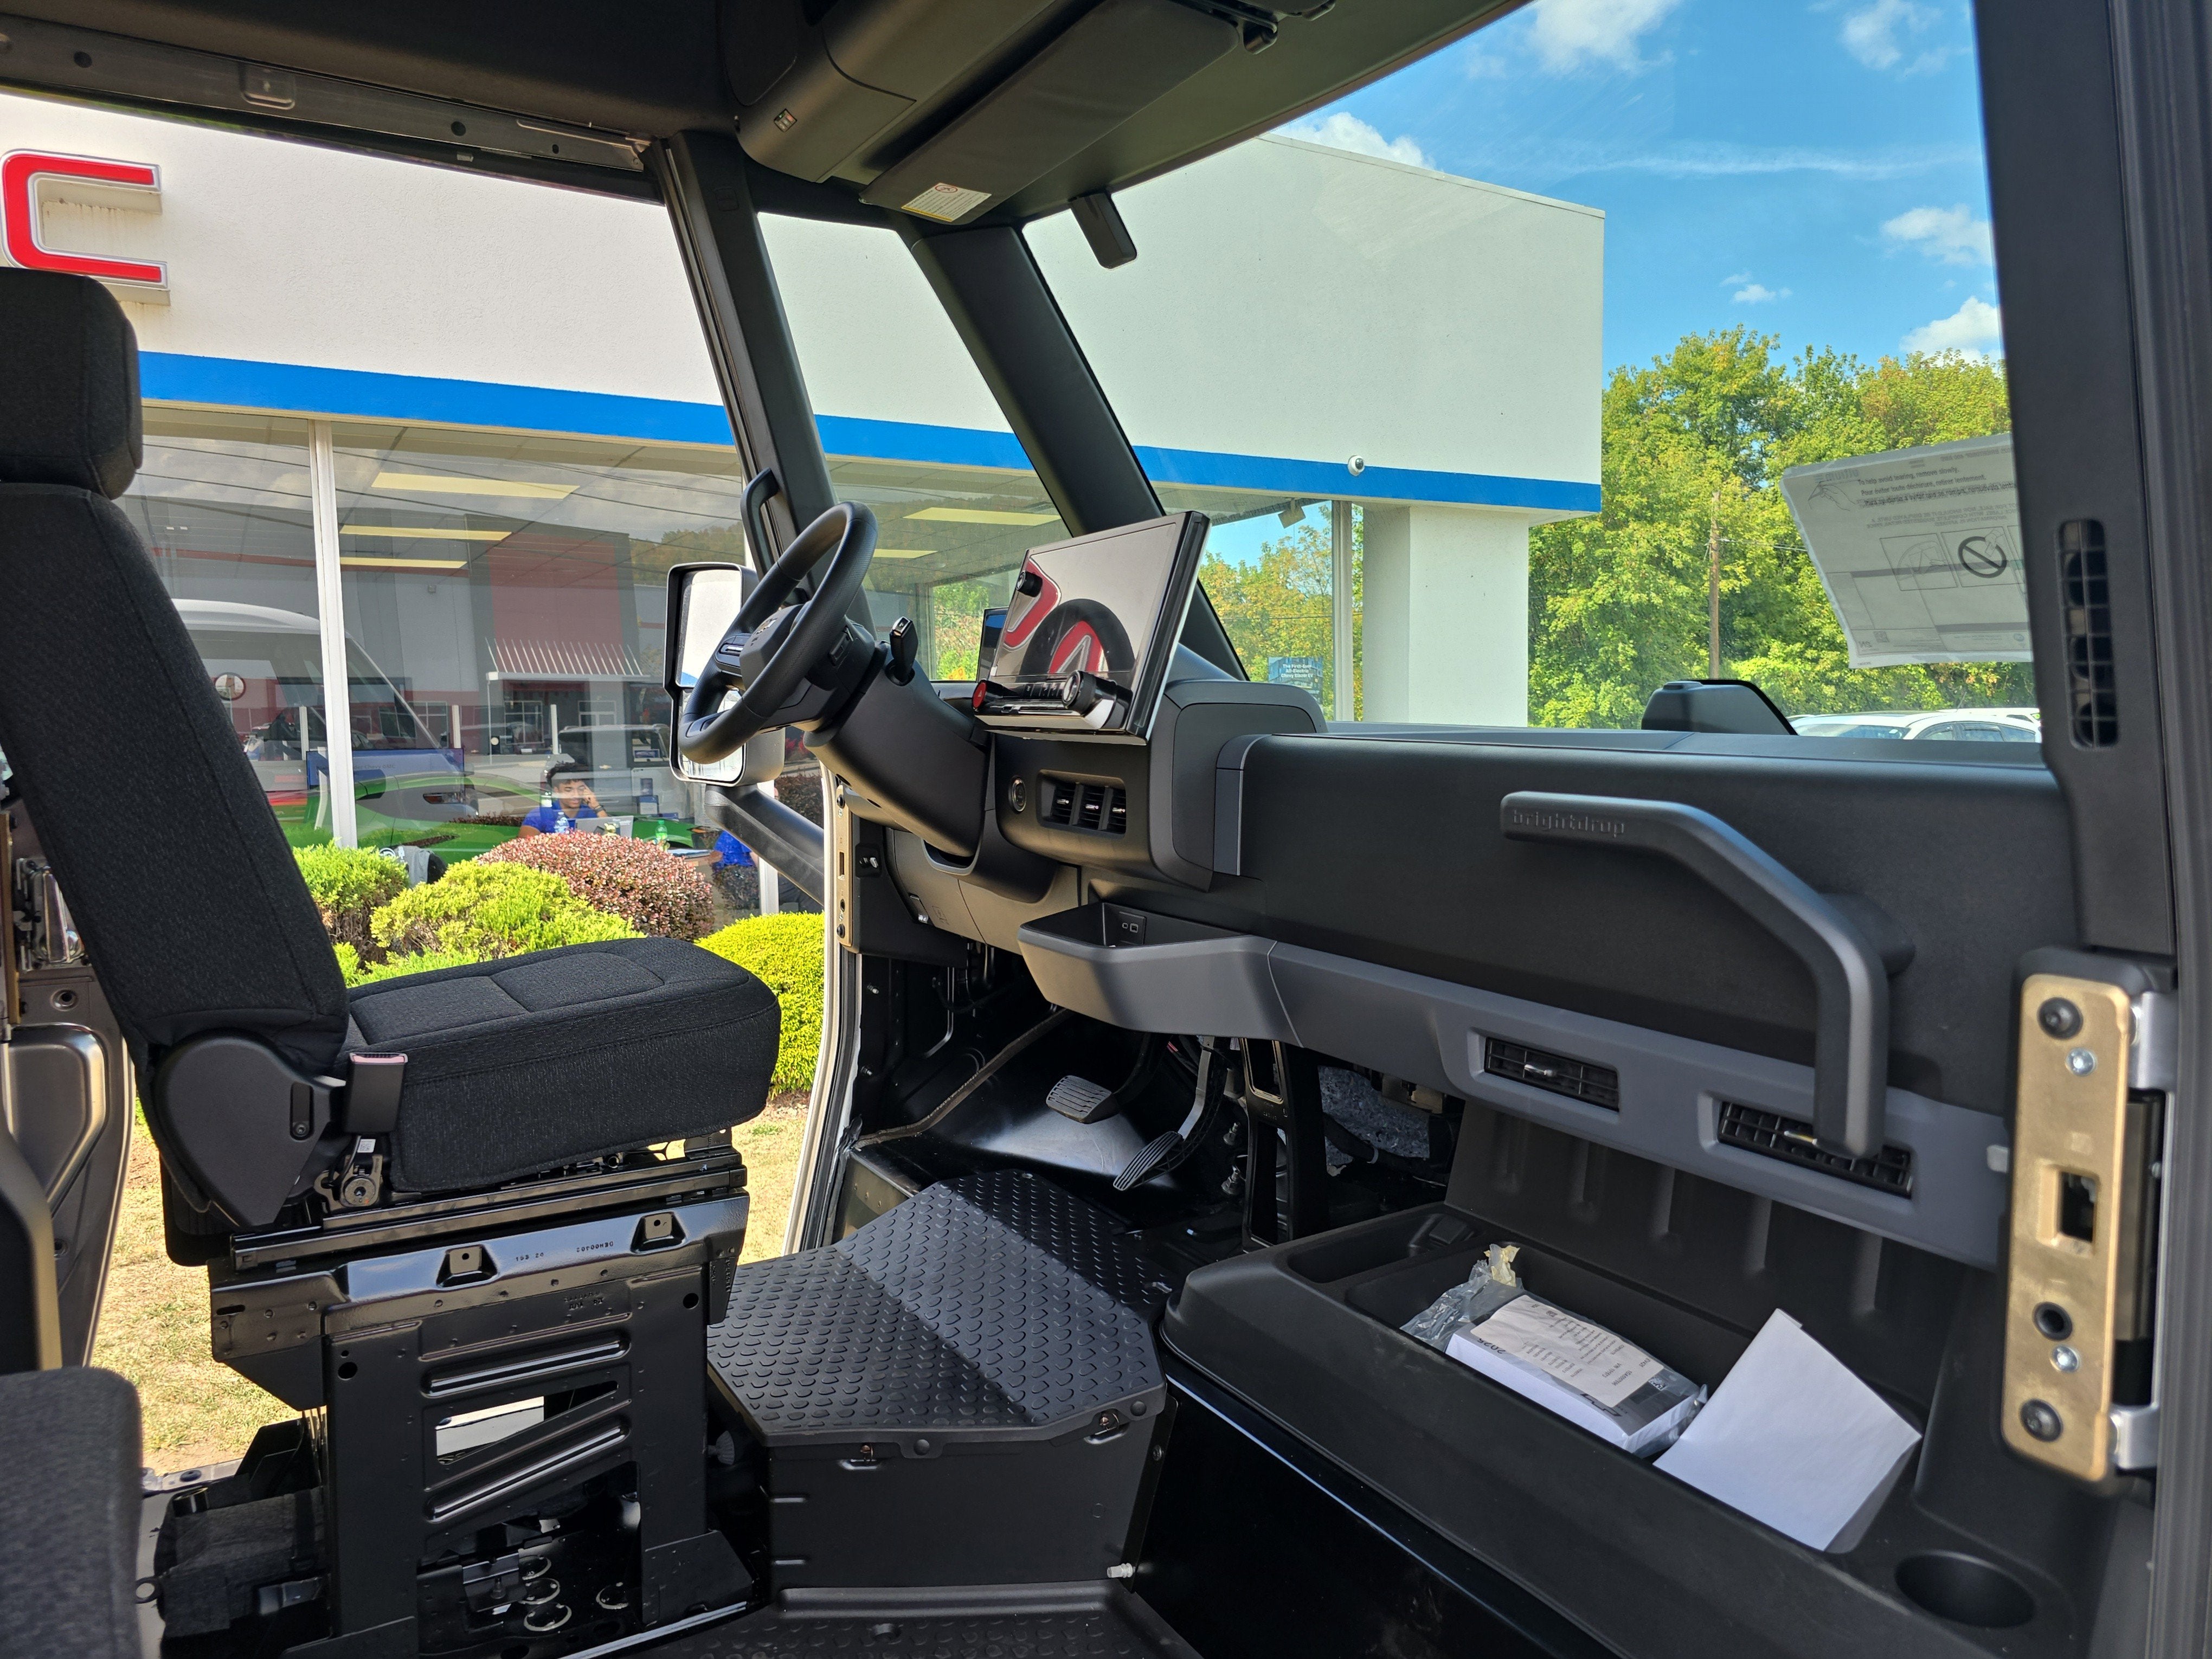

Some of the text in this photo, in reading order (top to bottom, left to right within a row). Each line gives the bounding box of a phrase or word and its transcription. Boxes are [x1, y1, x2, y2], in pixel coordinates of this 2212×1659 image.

[0, 148, 169, 290] C
[1894, 473, 1915, 482] tearing,
[1939, 467, 1959, 475] slowly.
[1955, 474, 1986, 484] lentement.
